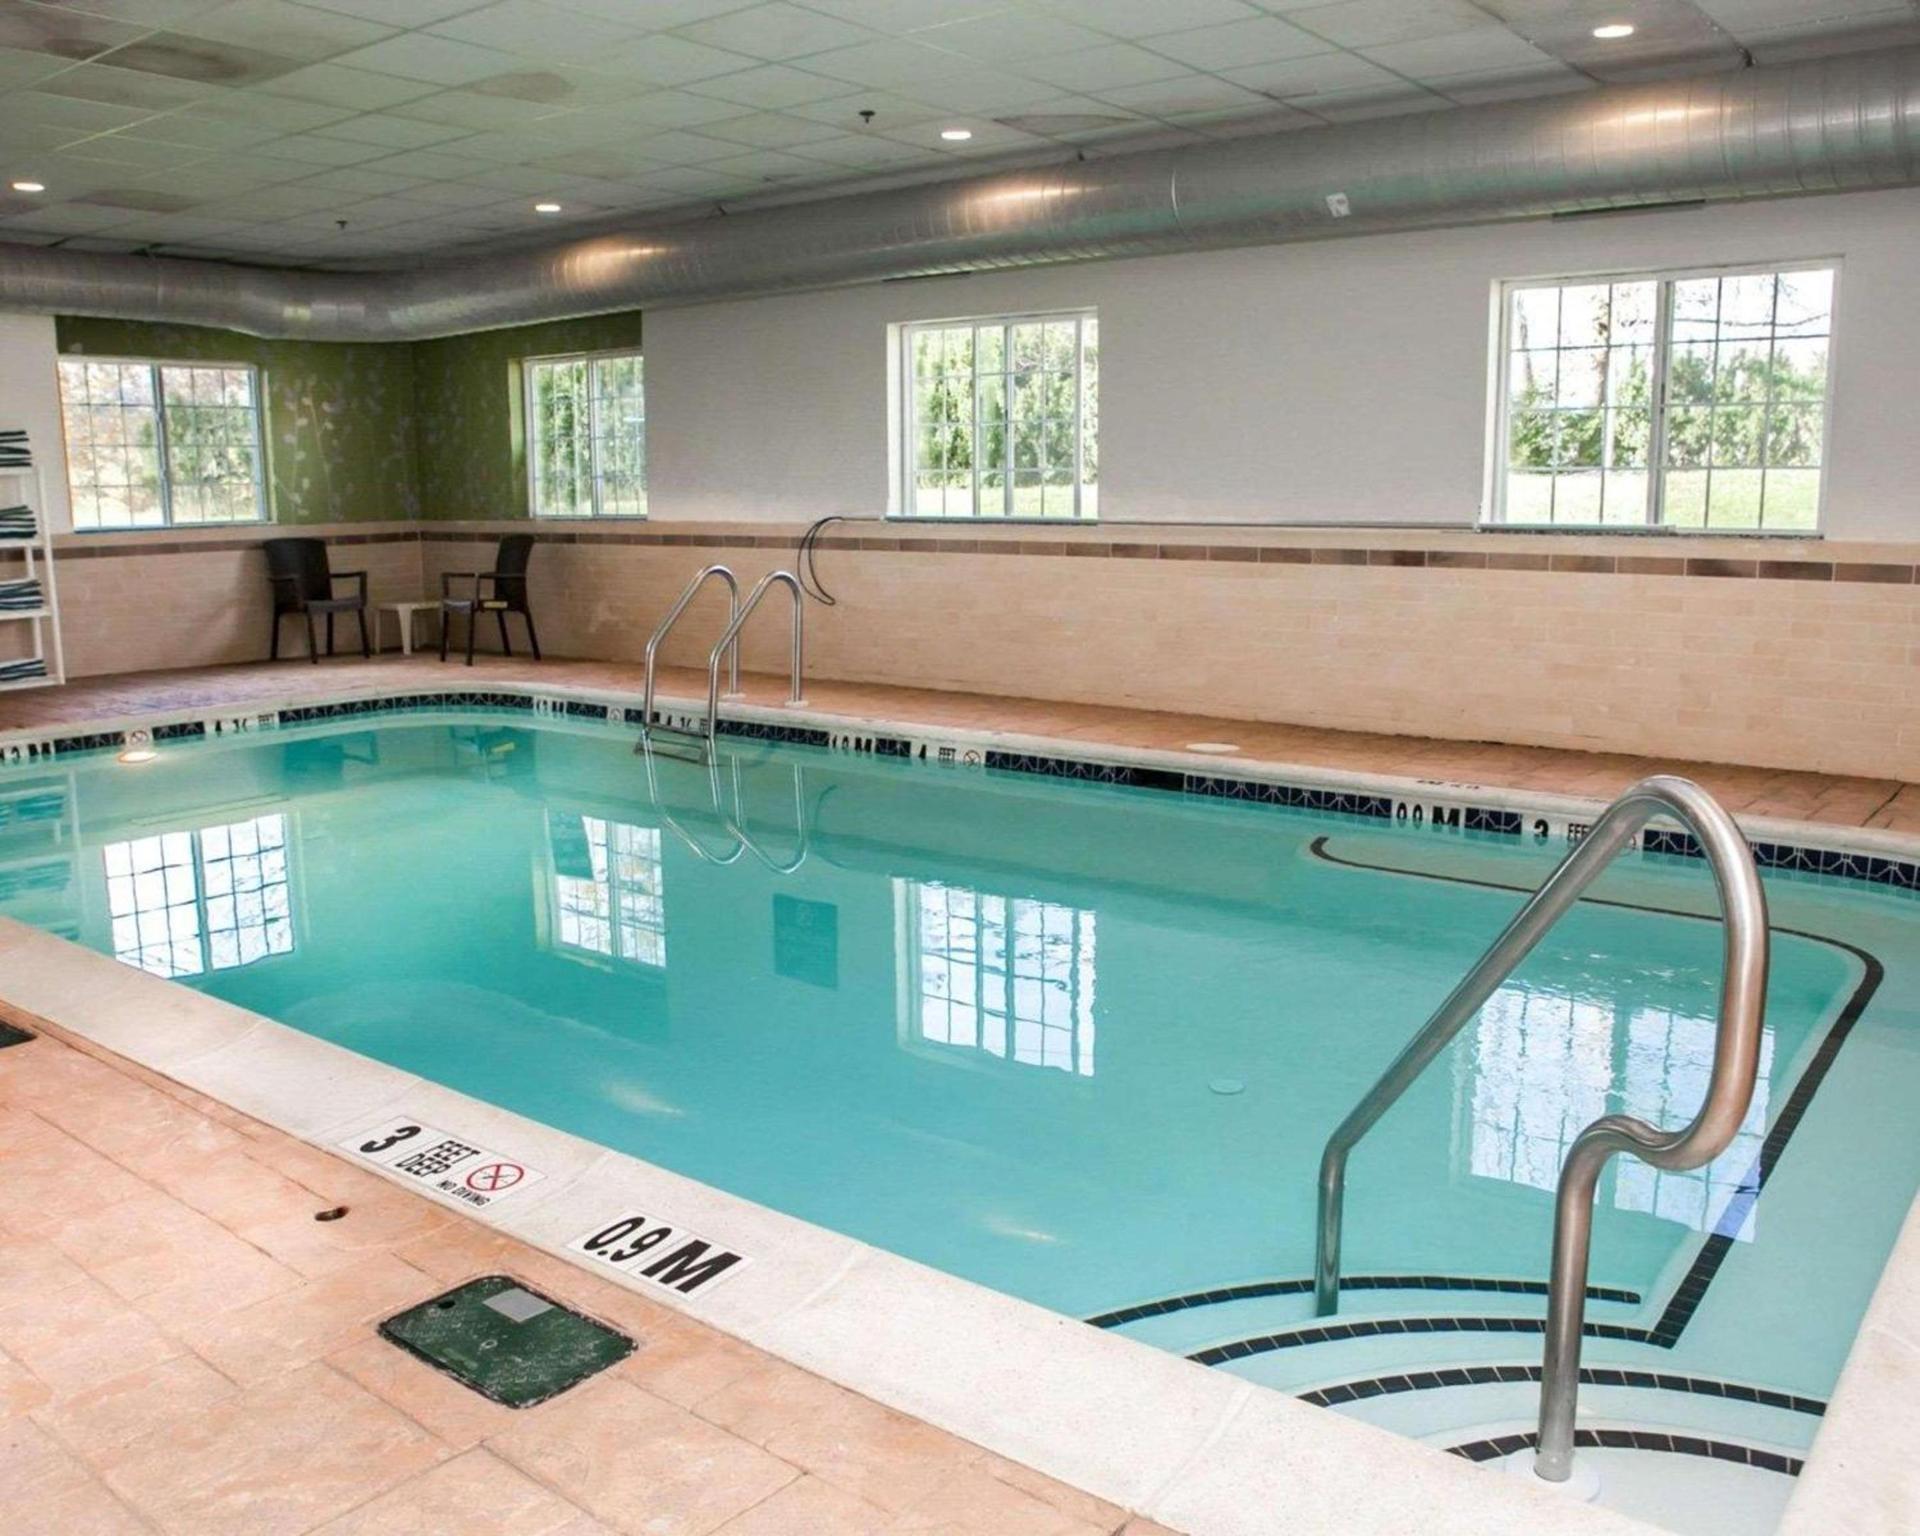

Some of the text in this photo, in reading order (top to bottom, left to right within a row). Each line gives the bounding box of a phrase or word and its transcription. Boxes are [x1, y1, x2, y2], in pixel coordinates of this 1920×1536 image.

[360, 1126, 422, 1153] 3
[425, 1140, 481, 1165] FEET
[395, 1153, 451, 1177] DEEP
[437, 1180, 491, 1206] NO DIVING
[583, 1216, 742, 1293] 0.9 M
